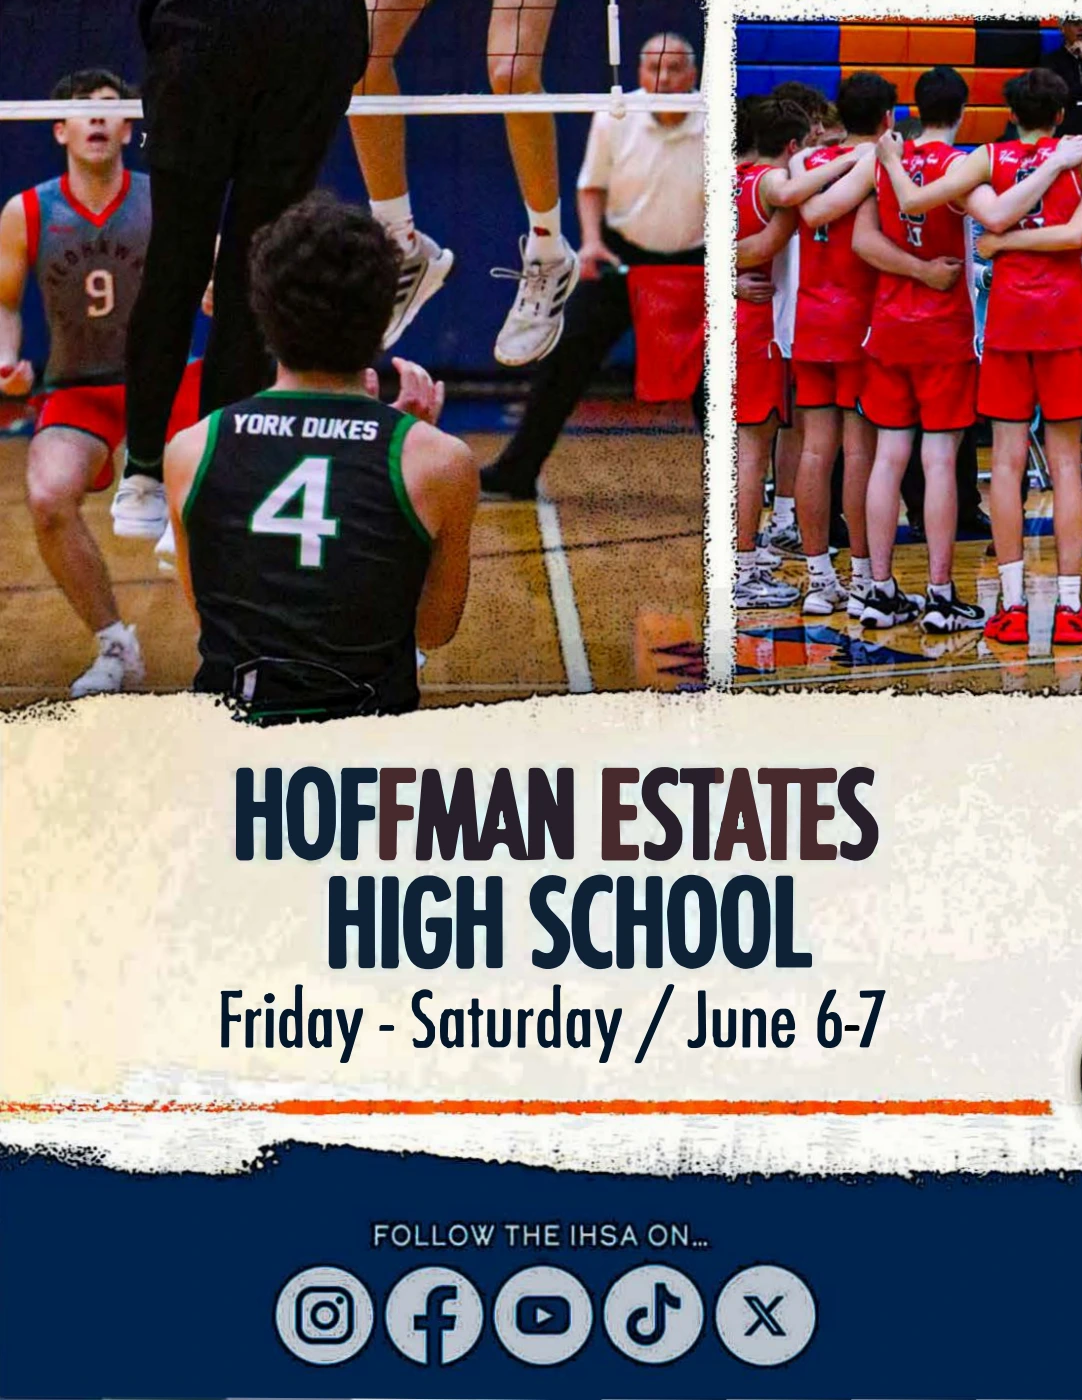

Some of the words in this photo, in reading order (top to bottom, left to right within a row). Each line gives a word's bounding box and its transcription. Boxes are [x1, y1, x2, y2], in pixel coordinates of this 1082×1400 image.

[85, 269, 115, 317] 9
[234, 413, 297, 437] YORK
[301, 416, 379, 441] DUKES
[250, 455, 340, 569] 4
[235, 766, 575, 862] HOFFMAN
[601, 766, 880, 862] ESTATES
[328, 874, 504, 970] HIGH
[530, 874, 813, 970] SCHOOL
[219, 984, 364, 1064] Friday
[411, 984, 624, 1064] Saturday
[634, 984, 675, 1064] /
[686, 990, 796, 1048] June
[816, 989, 887, 1049] 6-7
[373, 1224, 496, 1247] FOLLOW
[504, 1224, 560, 1247] THE
[570, 1224, 639, 1248] IHSA
